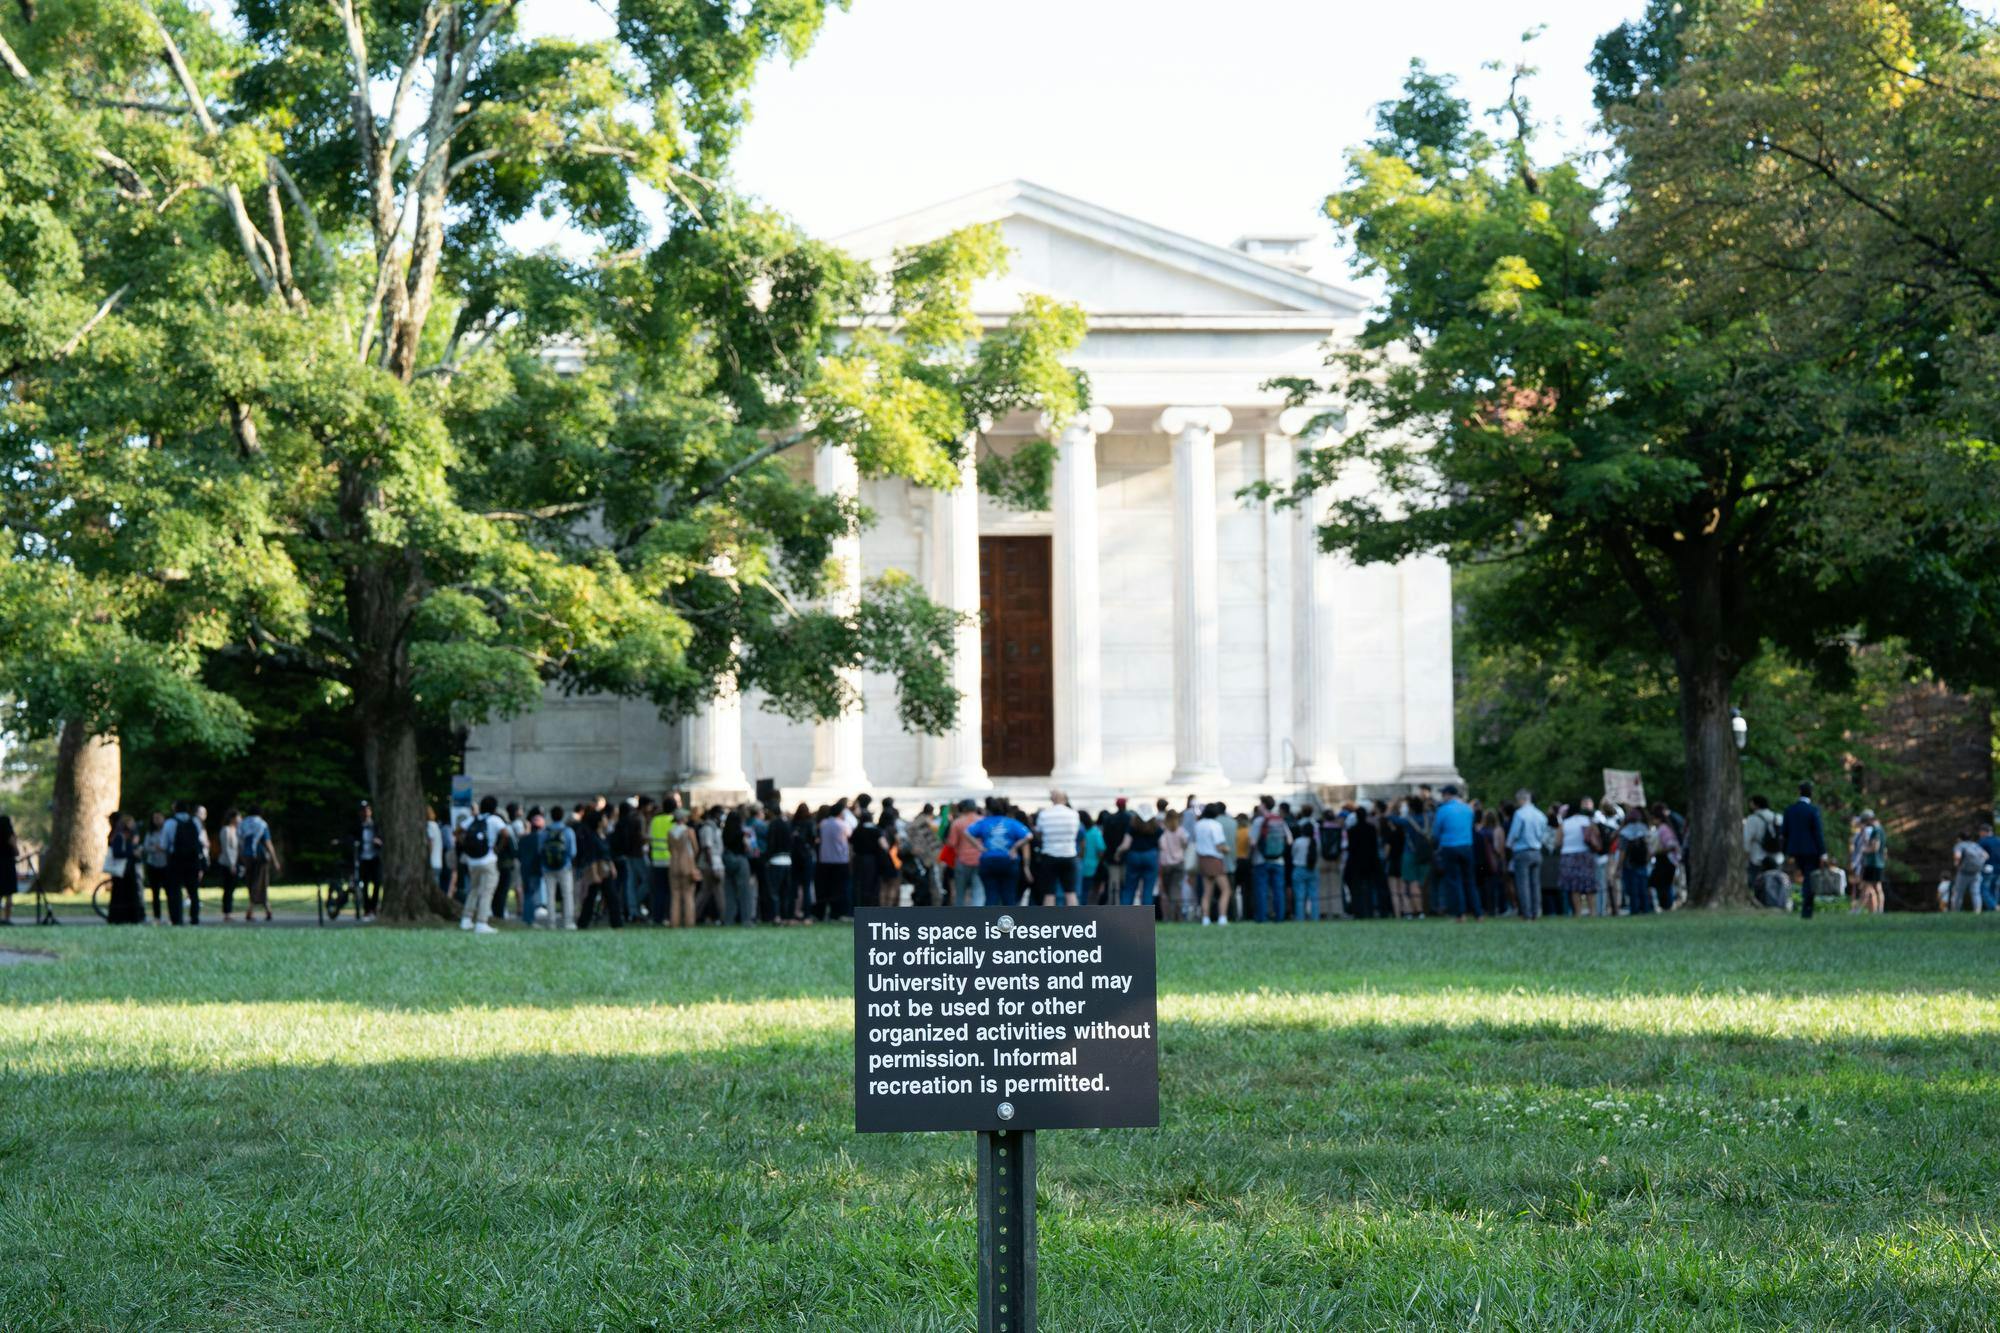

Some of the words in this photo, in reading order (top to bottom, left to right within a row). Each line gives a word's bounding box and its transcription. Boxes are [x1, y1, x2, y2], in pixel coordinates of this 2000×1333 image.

[868, 923, 910, 940] This
[918, 926, 977, 944] space
[985, 922, 1001, 939] is
[1009, 921, 1097, 939] reserved
[869, 948, 896, 965] for
[903, 947, 985, 969] officially
[992, 946, 1101, 964] sanctioned
[869, 973, 967, 995] University
[974, 974, 1039, 990] events
[1047, 972, 1083, 989] and
[1092, 975, 1132, 993] may
[869, 1000, 900, 1017] not
[909, 999, 933, 1016] be
[941, 998, 989, 1016] used
[997, 998, 1024, 1015] for
[1032, 997, 1085, 1015] other
[869, 1023, 968, 1046] organized
[977, 1023, 1066, 1041] activities
[1074, 1021, 1150, 1039] without
[870, 1049, 984, 1073] permission.
[994, 1048, 1076, 1066] Informal
[870, 1076, 972, 1094] recreation
[981, 1075, 997, 1093] is
[1006, 1073, 1109, 1097] permitted.
